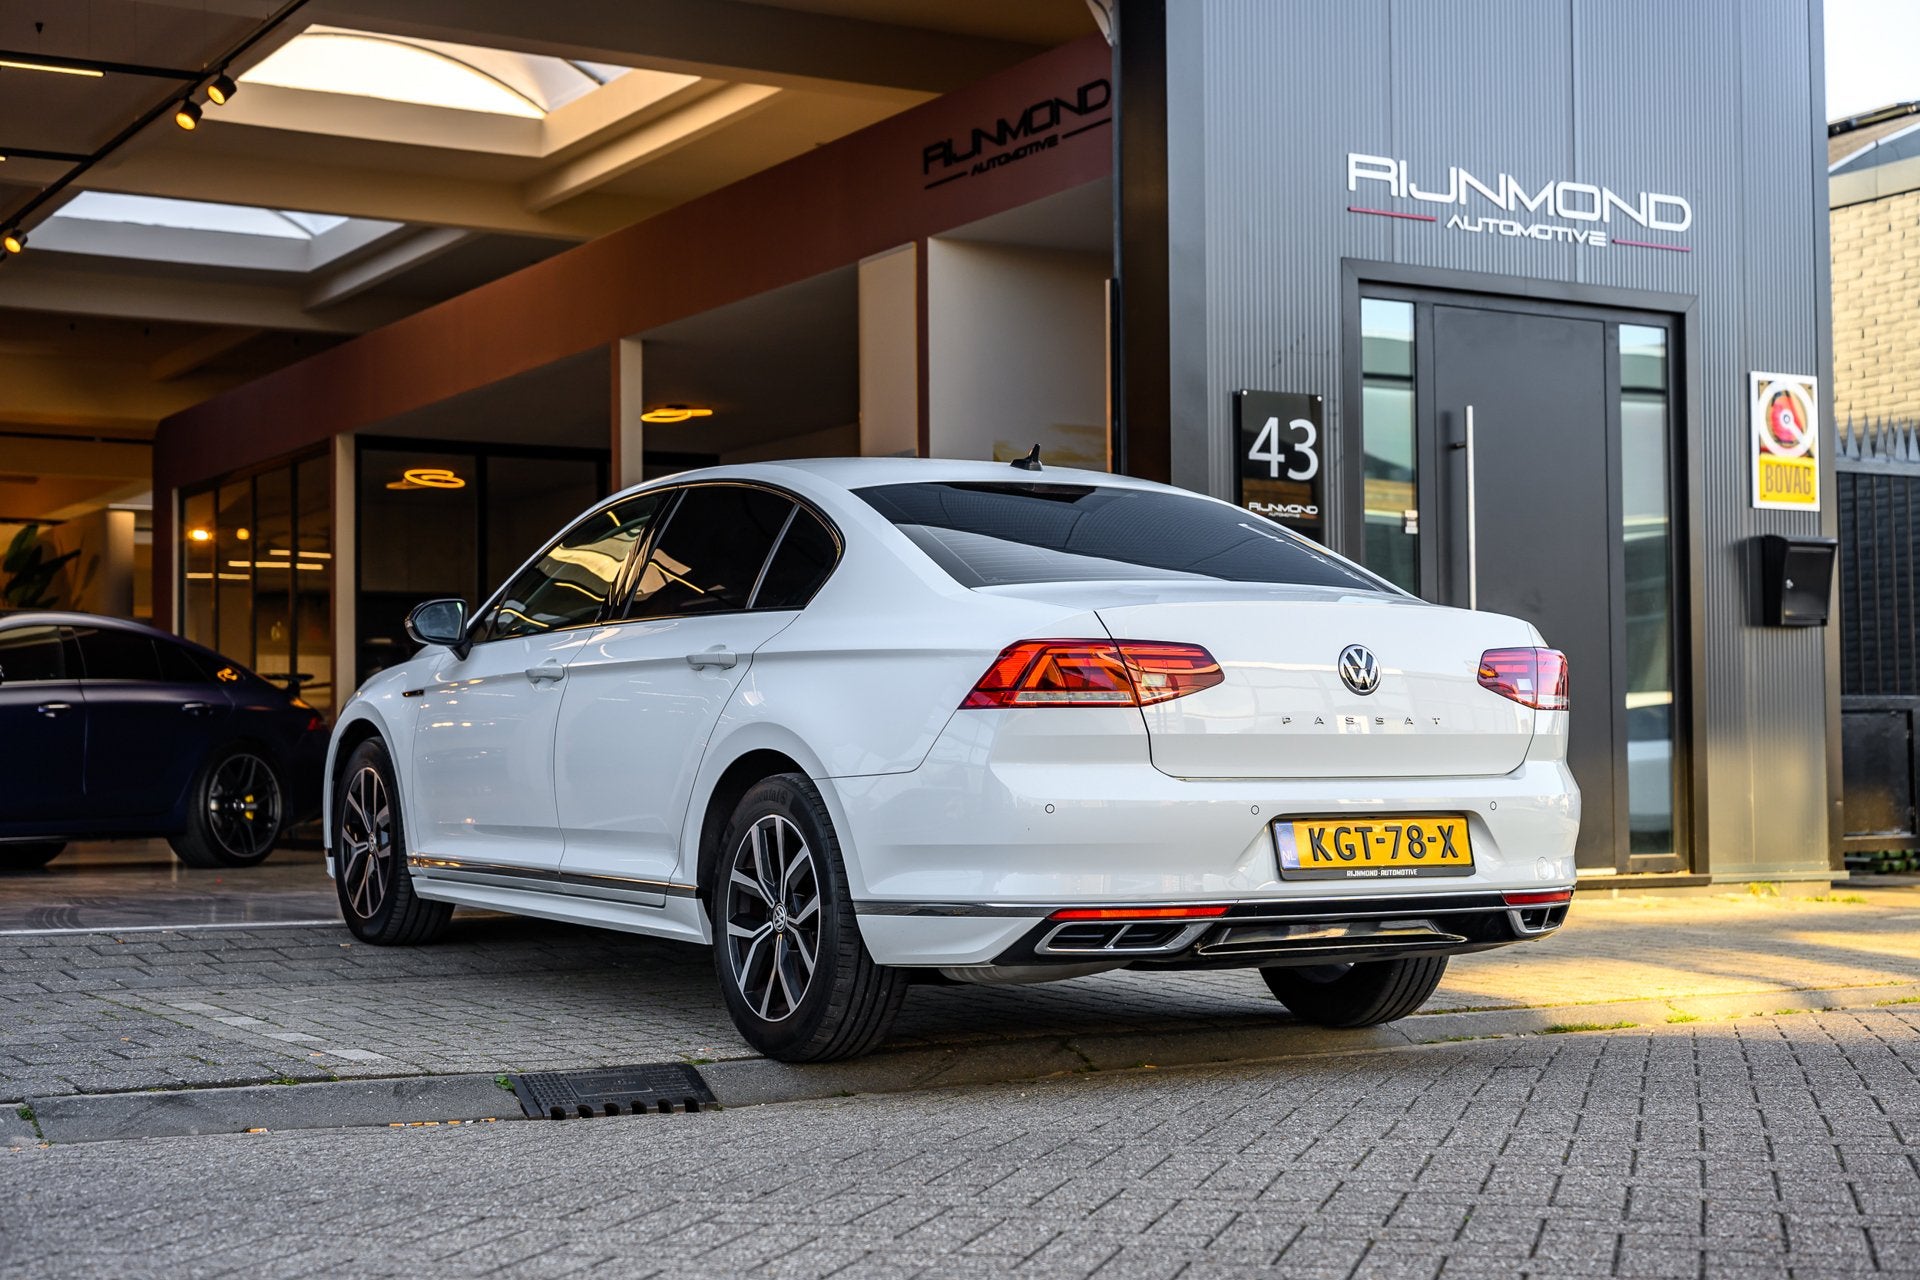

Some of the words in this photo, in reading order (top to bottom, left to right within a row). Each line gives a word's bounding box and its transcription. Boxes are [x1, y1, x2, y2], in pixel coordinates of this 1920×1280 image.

[924, 79, 1111, 174] RIJNMOND
[971, 134, 1059, 176] AUTOMOTIVE
[1348, 152, 1692, 232] RIJNMOND
[1447, 214, 1607, 247] AUTOMOTIVE
[1248, 416, 1319, 481] 43
[1765, 464, 1811, 495] BOVAG
[1248, 502, 1318, 514] RIJNMOND
[1281, 715, 1442, 726] PASSAT
[1283, 850, 1297, 861] NL
[1308, 824, 1459, 862] KGT-78-X
